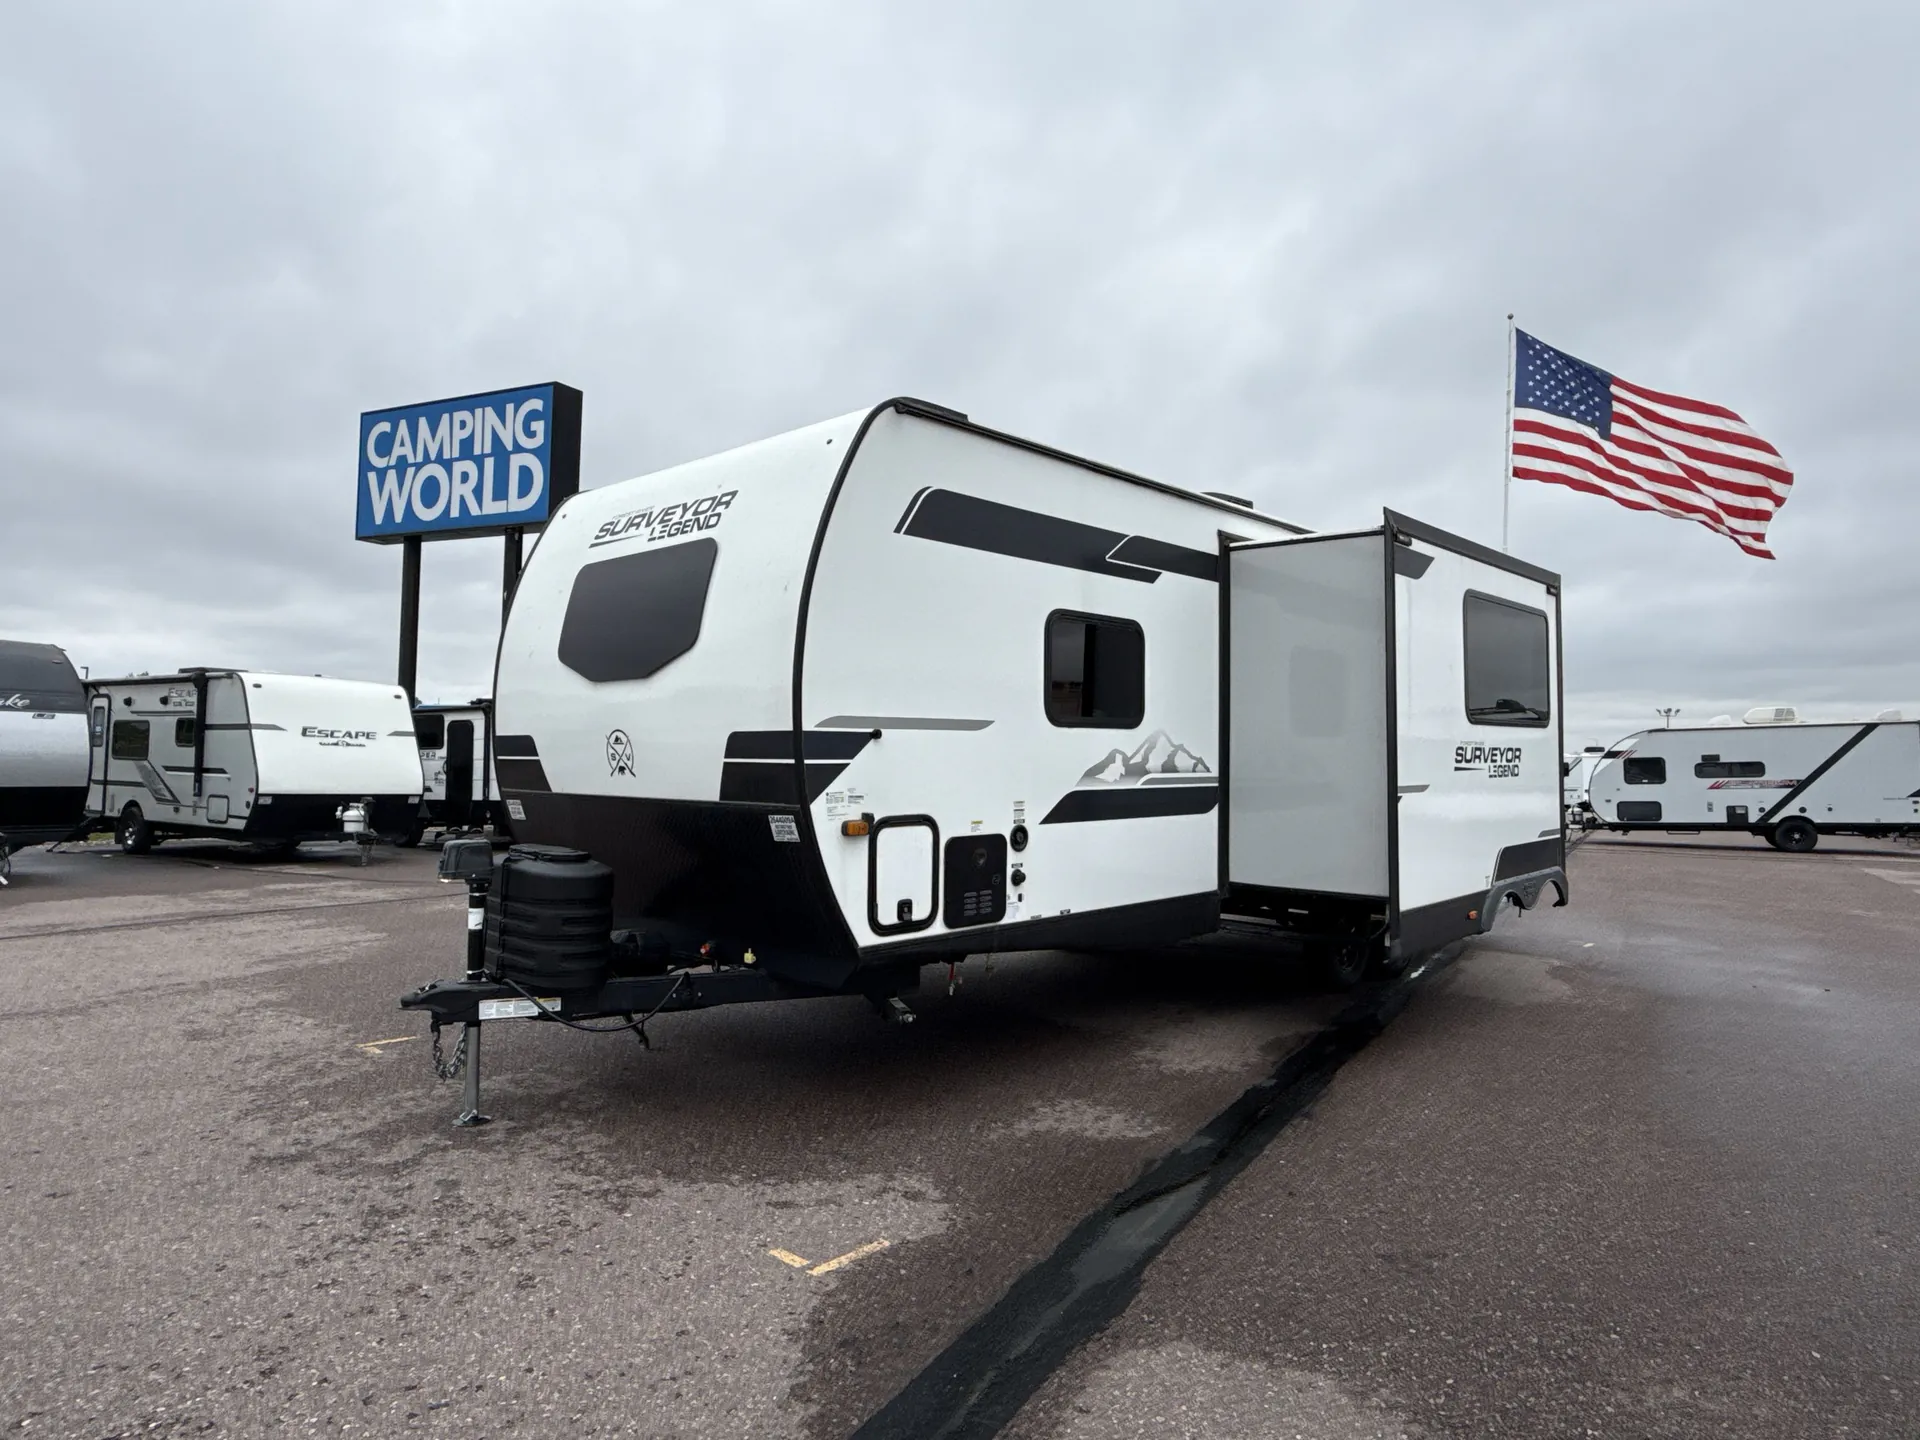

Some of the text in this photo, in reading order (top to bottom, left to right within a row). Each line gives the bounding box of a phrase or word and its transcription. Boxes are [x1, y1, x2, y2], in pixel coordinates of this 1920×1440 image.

[366, 398, 544, 469] CAMPING
[367, 452, 544, 525] WORLD
[594, 490, 739, 540] SURVEYOR
[647, 512, 722, 542] LEGEND
[301, 726, 377, 740] ESCAPE
[1455, 746, 1522, 764] SURVEYOR
[1488, 764, 1520, 779] LEGEND
